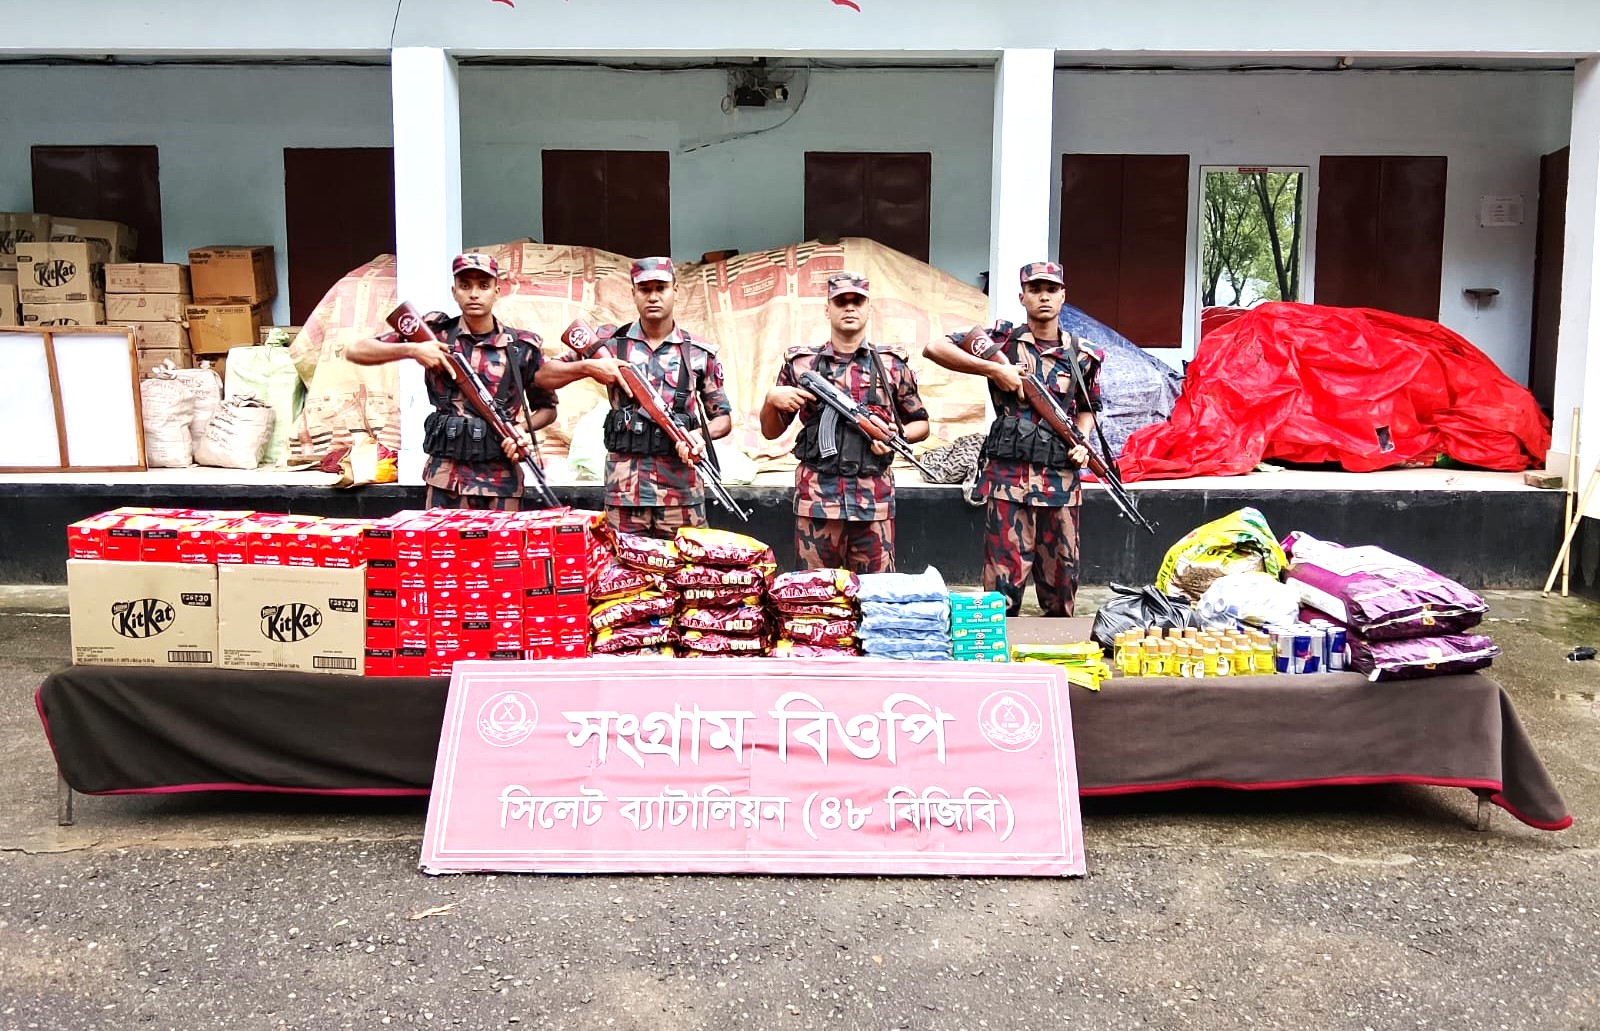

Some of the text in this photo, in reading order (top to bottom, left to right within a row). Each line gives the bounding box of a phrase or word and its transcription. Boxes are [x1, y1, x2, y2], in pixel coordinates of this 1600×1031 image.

[38, 260, 76, 287] KitKat
[120, 599, 173, 638] KitKat
[268, 603, 320, 641] KitKat
[562, 691, 957, 769] সংগ্রাম বিওপি
[498, 784, 1016, 841] সিলেট ব্যাটালিয়ন (৪৮ বিজিবি)
